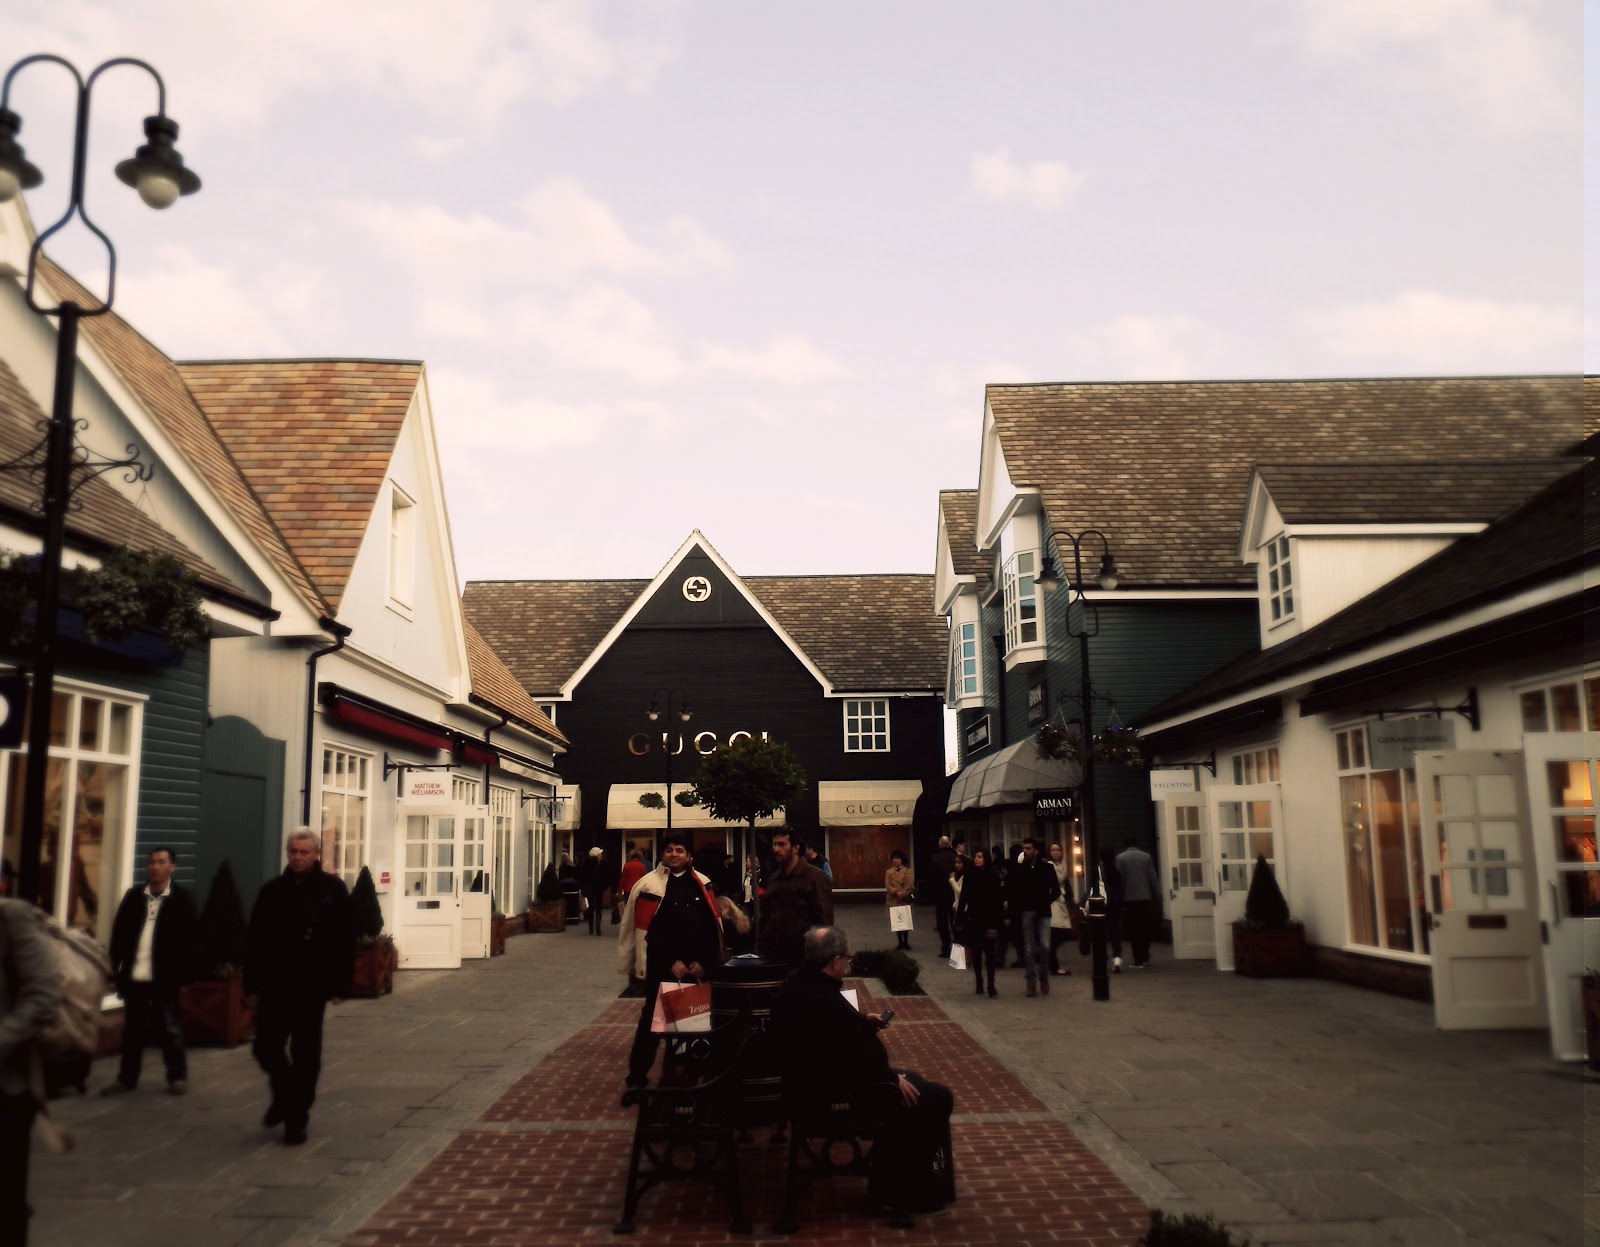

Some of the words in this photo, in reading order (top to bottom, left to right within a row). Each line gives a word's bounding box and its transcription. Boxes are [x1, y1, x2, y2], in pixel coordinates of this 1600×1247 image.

[1036, 797, 1072, 809] ARMANI
[846, 804, 899, 814] GUCCI
[1036, 808, 1072, 817] OUTLET
[688, 1003, 711, 1014] Zegna
